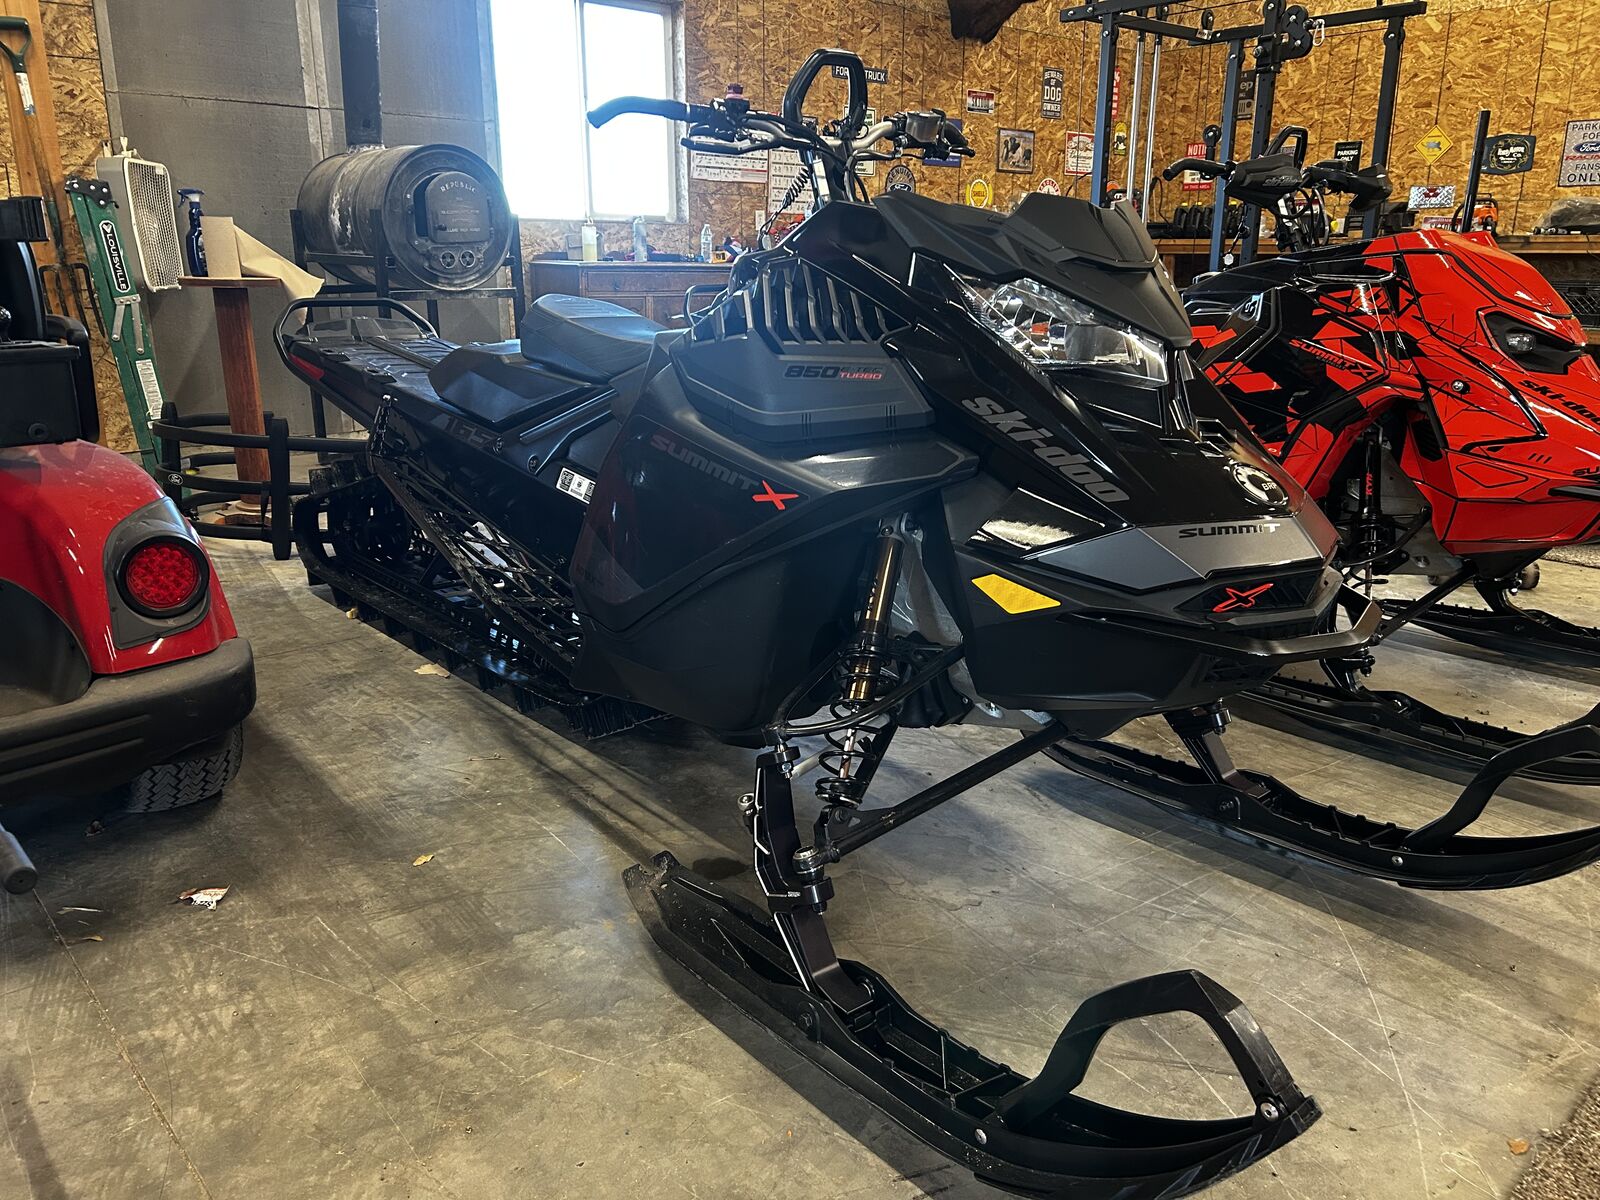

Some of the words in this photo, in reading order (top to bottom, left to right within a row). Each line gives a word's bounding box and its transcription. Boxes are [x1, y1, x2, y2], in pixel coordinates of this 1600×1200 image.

[865, 70, 885, 81] TRUCK
[1043, 85, 1061, 102] DOG
[1571, 122, 1600, 132] PARK
[1337, 149, 1359, 157] PARKING
[439, 180, 477, 194] REPUBLIC
[106, 232, 128, 291] LOUISVILLE
[1288, 338, 1358, 368] SUMMIT
[784, 365, 840, 379] 850
[840, 371, 883, 380] TURBO
[650, 433, 760, 491] SUMMIT
[1261, 482, 1278, 491] BRP
[1178, 522, 1281, 539] SUMMIT
